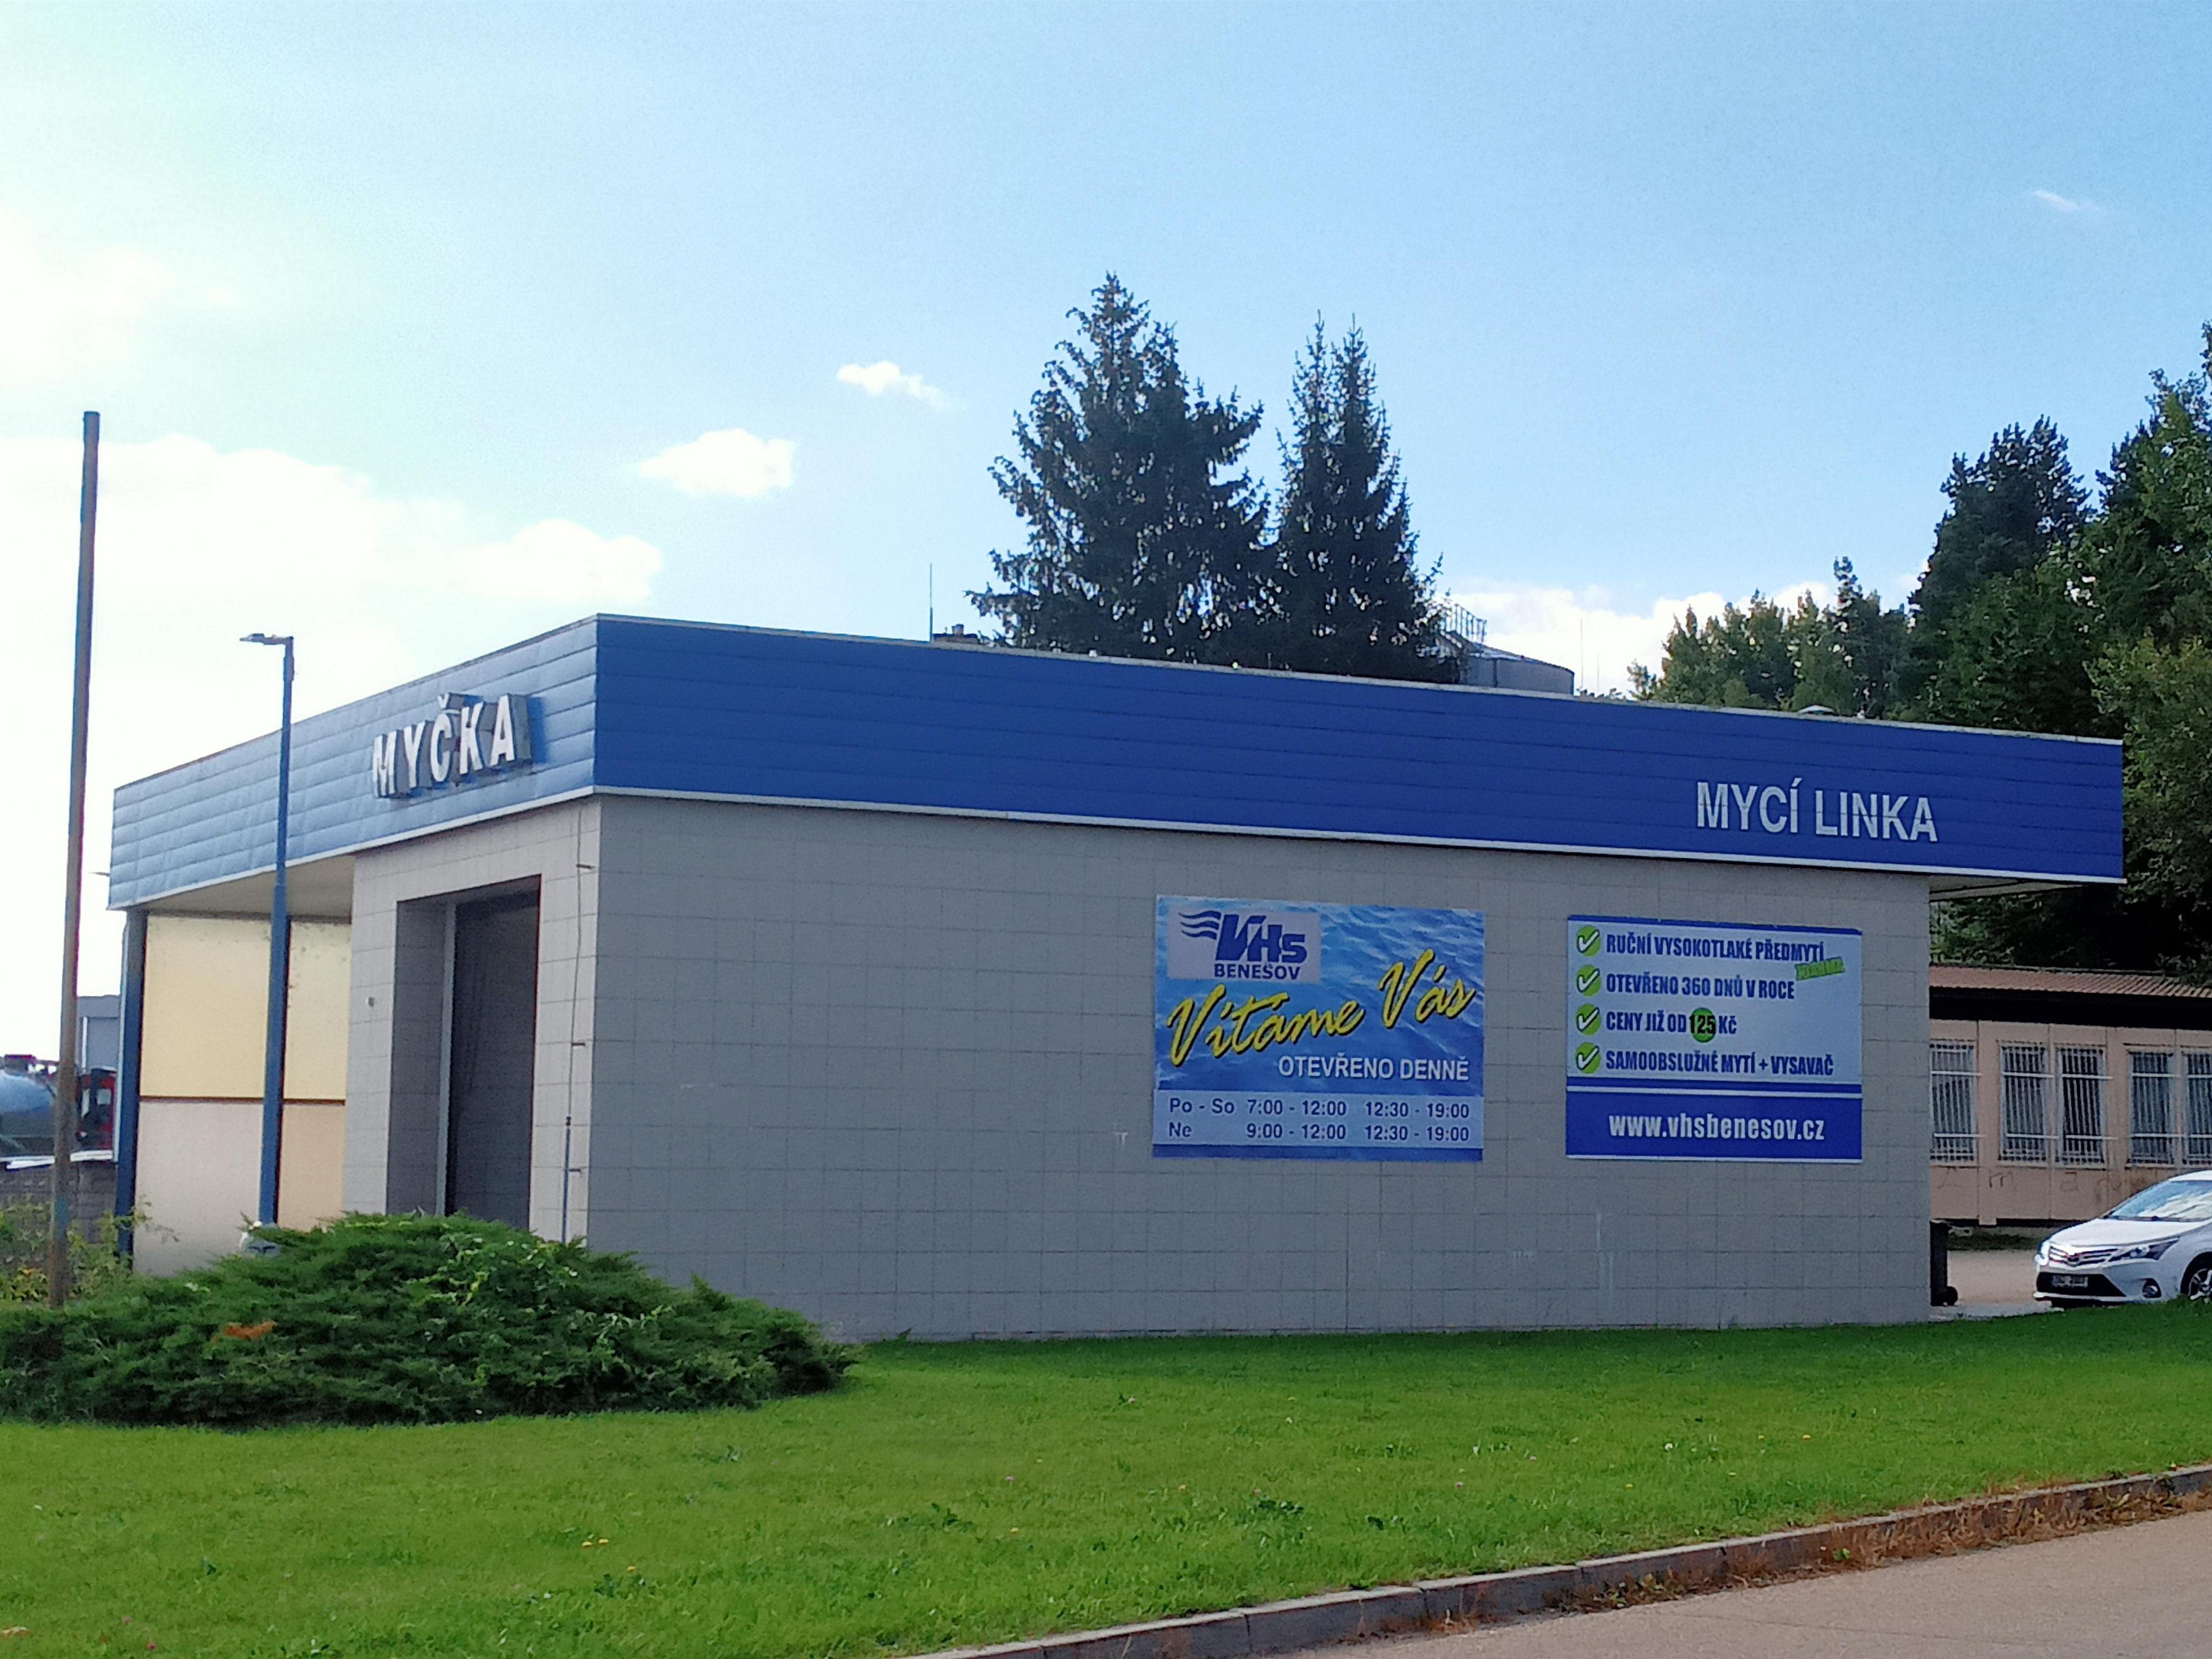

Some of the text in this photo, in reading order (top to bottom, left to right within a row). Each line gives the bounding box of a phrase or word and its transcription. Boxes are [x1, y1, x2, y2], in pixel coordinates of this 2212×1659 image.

[373, 693, 515, 797] MYČKA
[1697, 778, 1937, 842] MYCÍ LINKA
[1606, 931, 1824, 962] RUČNÍ VYSOKOTLAKÉ PŘEDMYTÍ
[1214, 963, 1300, 980] BENEŠOV
[1379, 949, 1475, 1029] Vás
[1606, 972, 1794, 999] OTEVŘENO 360 DNŮ V ROCE
[1606, 1011, 1642, 1031] CENY
[1645, 1008, 1665, 1032] JIŽ
[1667, 1014, 1687, 1032] OD
[1689, 1015, 1716, 1034] 125
[1279, 1052, 1469, 1081] OTEVŘENO DENNĚ
[1606, 1051, 1834, 1076] SAMOOBSLUŽNÉ MYTÍ + VYSAVAČ
[1169, 1098, 1192, 1113] Po
[1212, 1099, 1234, 1113] So
[1247, 1099, 1282, 1115] 7:00
[1302, 1100, 1347, 1116] 12:00
[1365, 1102, 1409, 1117] 12:30
[1427, 1103, 1469, 1118] 19:00
[1168, 1122, 1192, 1138] Ne
[1247, 1123, 1282, 1139] 9:00
[1302, 1124, 1346, 1140] 12:00
[1364, 1125, 1408, 1141] 12:30
[1427, 1126, 1469, 1142] 19:00
[1609, 1113, 1824, 1140] www.vhsbenesov.cz
